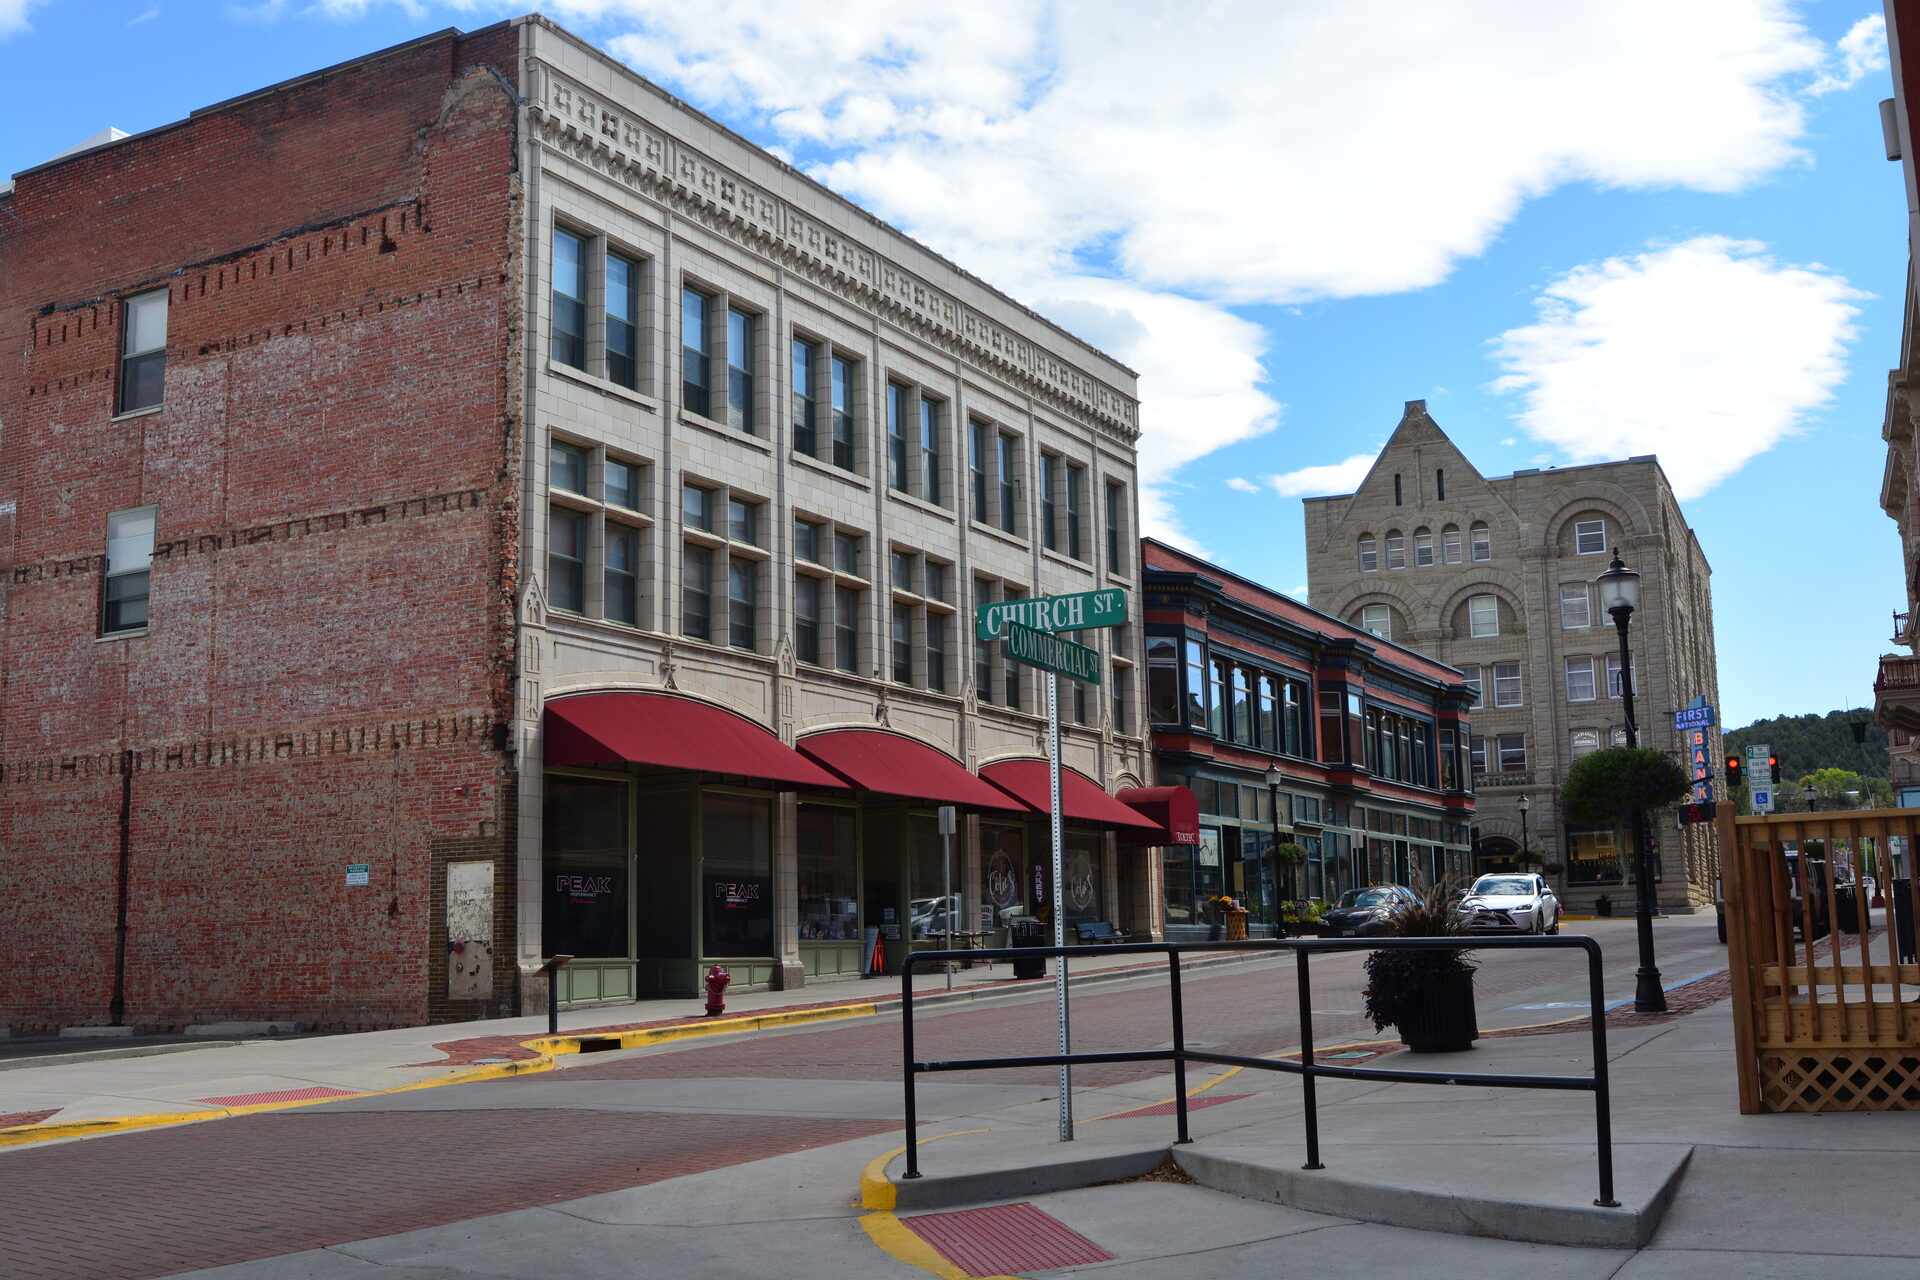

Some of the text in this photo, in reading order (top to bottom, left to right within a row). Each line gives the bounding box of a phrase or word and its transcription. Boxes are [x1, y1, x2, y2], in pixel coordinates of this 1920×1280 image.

[986, 593, 1114, 635] CHURCH ST
[1010, 624, 1099, 678] COMMERCIAL ST
[1675, 707, 1710, 722] FIRST
[1675, 719, 1710, 730] NATIONAL
[1694, 731, 1708, 800] BANK
[556, 875, 611, 893] PEAK
[715, 883, 759, 899] PEAK
[1035, 865, 1043, 903] BAKERY
